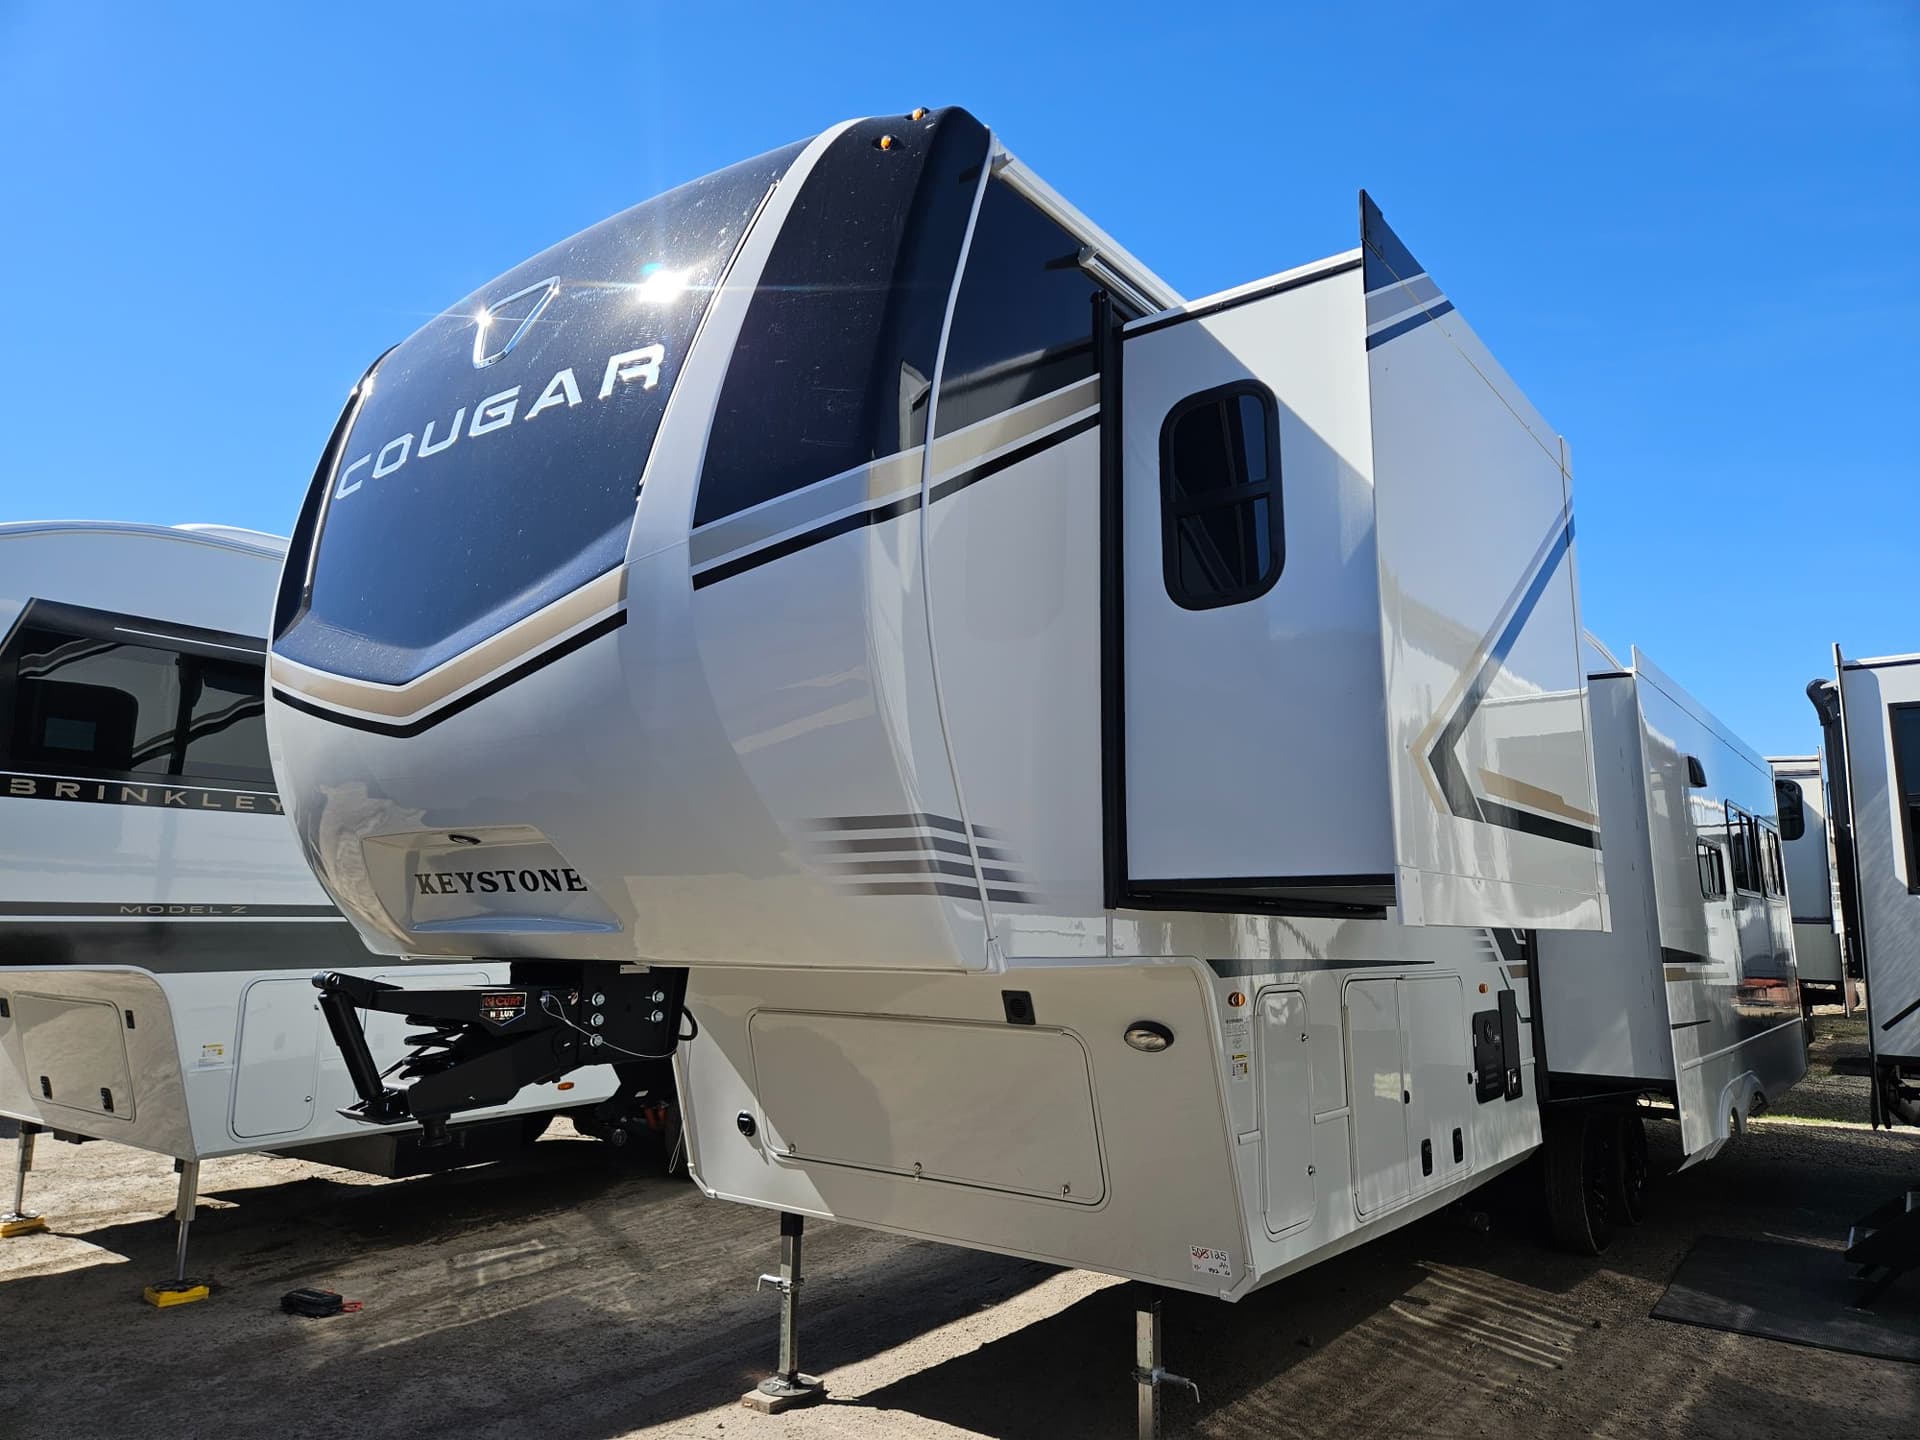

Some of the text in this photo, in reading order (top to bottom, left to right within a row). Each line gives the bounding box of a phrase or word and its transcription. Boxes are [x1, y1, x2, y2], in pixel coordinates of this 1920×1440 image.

[335, 343, 666, 500] COUGAR
[414, 868, 588, 895] KEYSTONE
[119, 904, 249, 915] MODEL Z
